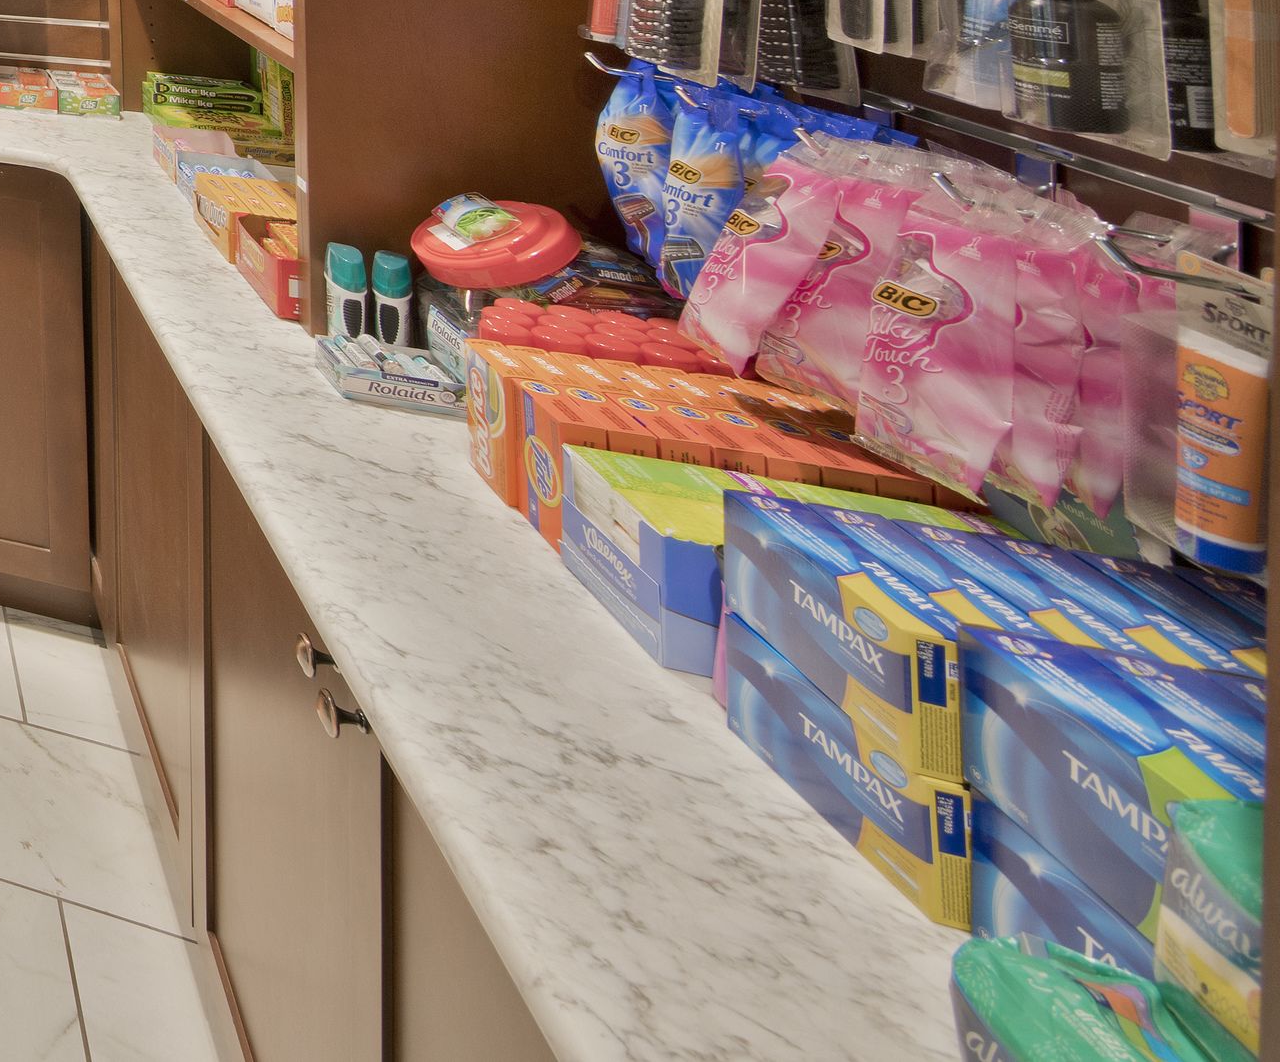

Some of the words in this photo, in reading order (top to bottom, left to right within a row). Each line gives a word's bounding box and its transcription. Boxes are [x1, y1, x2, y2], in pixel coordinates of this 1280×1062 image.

[169, 95, 196, 105] Mike
[197, 99, 214, 108] Ike
[171, 85, 199, 94] Mike
[200, 89, 217, 97] Ike
[598, 142, 654, 165] Comfort
[613, 161, 633, 188] 3
[670, 163, 698, 182] BiC
[665, 198, 681, 227] 3
[727, 213, 758, 232] BiC
[701, 253, 738, 281] Touch
[697, 276, 718, 305] 3
[877, 282, 933, 314] BiC
[786, 304, 801, 331] 3
[864, 306, 921, 349] Silky
[1202, 302, 1271, 344] SPORT
[431, 319, 462, 350] Rolaids
[862, 337, 943, 374] Touch
[368, 381, 436, 403] Rolaids
[386, 374, 408, 382] EXTRA
[885, 366, 909, 405] 3
[583, 524, 633, 588] Kleenex
[788, 579, 885, 676] TAMPAX
[797, 712, 903, 823] TAMPAX
